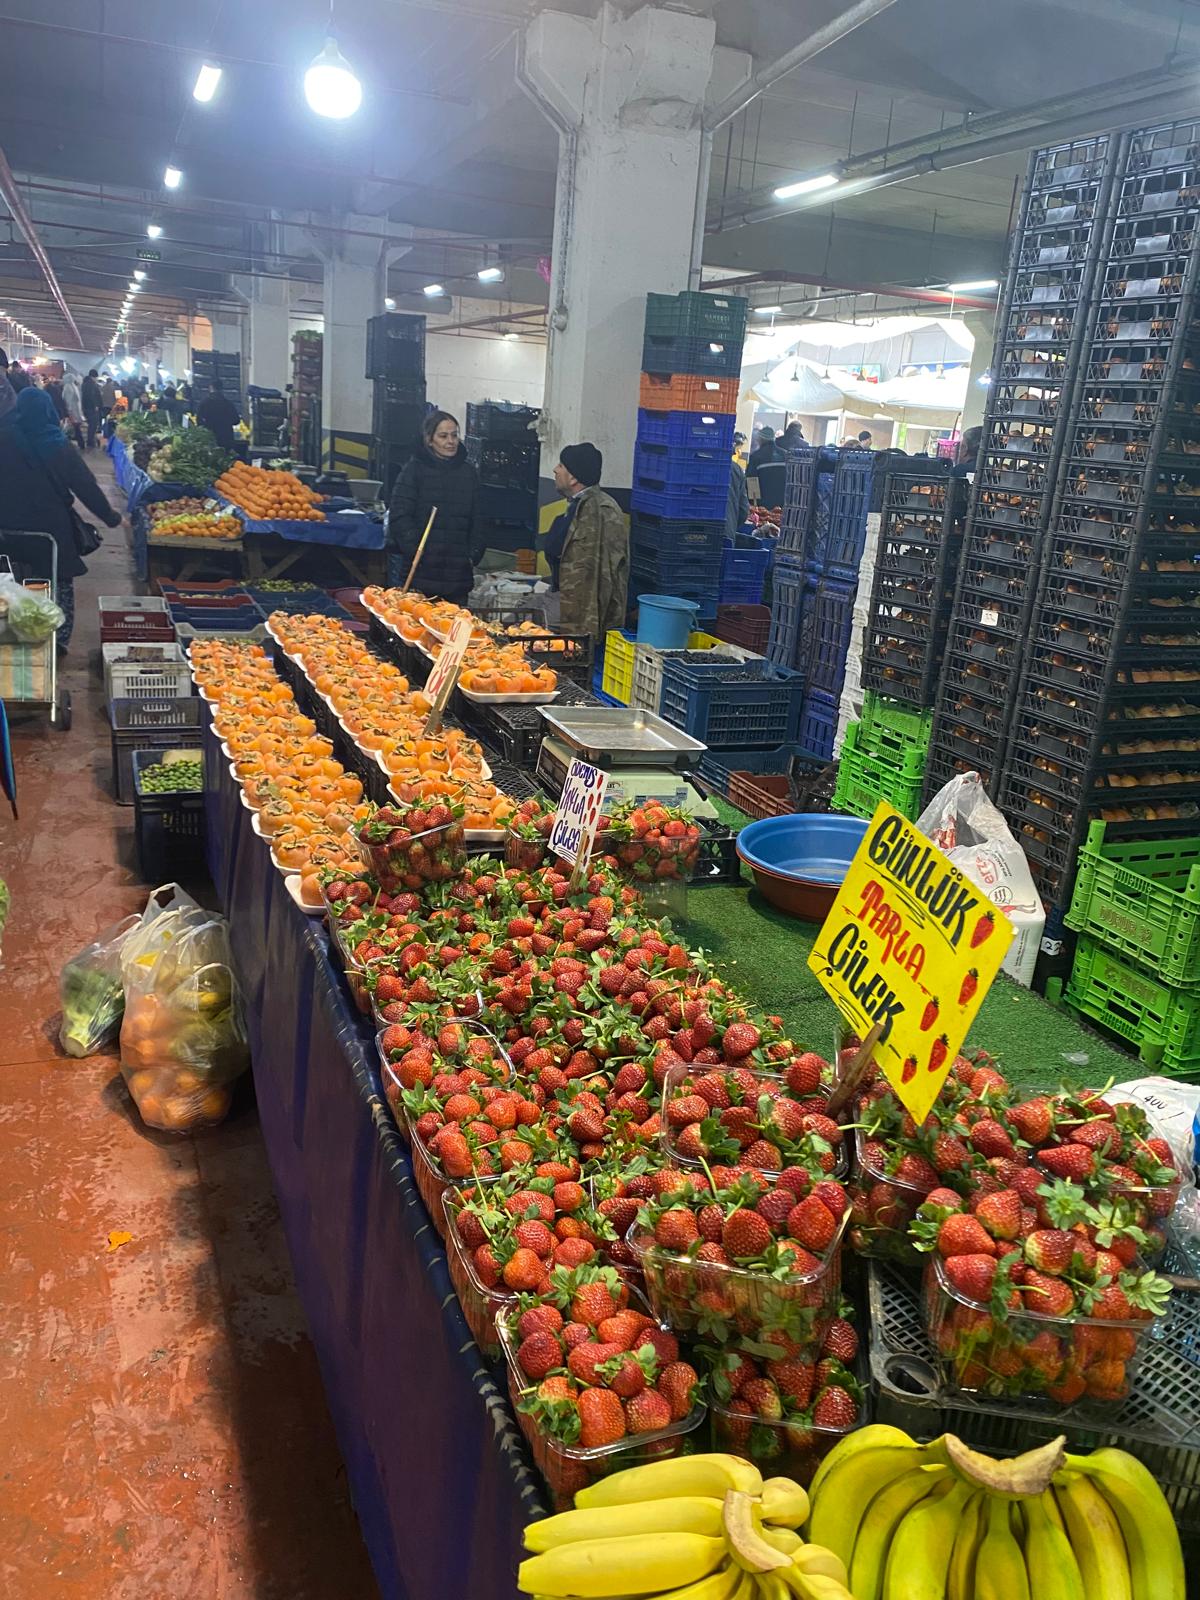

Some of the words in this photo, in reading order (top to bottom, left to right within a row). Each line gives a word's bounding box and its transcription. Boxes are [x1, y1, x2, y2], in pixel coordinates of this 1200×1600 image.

[857, 879, 927, 983] TARLA
[867, 814, 979, 948] GÜNLÜK
[827, 922, 905, 1046] ÇİLEK
